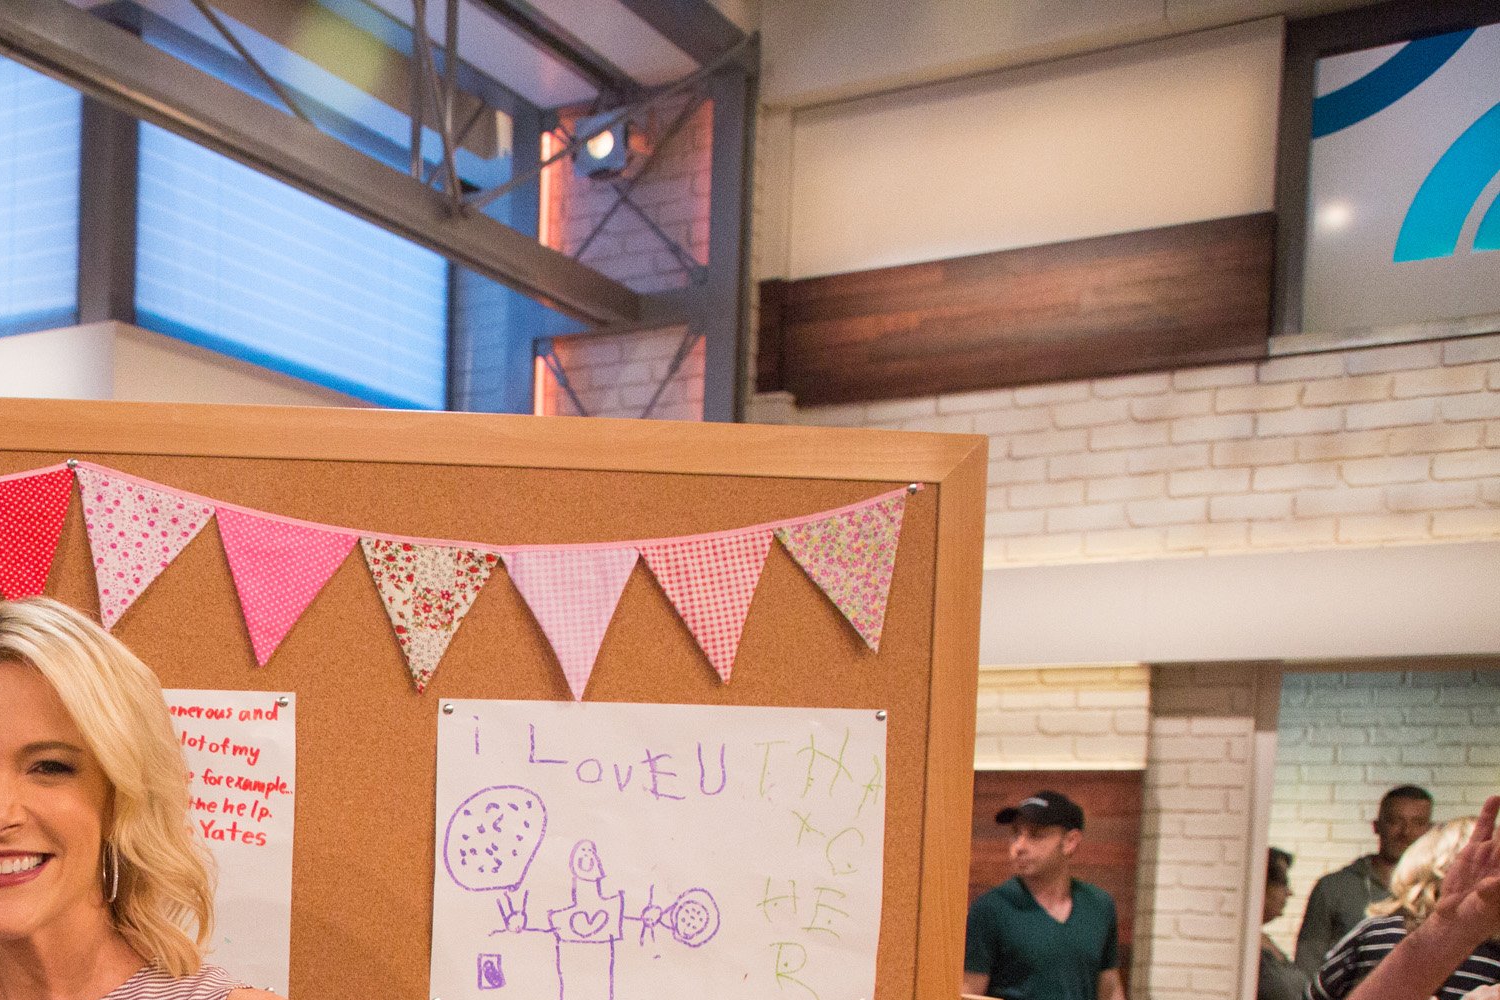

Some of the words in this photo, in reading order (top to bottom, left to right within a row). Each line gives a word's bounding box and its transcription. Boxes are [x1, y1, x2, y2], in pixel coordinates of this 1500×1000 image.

[169, 705, 233, 720] enerous
[238, 701, 280, 722] and
[209, 737, 231, 755] of
[231, 744, 261, 767] my
[201, 768, 224, 787] for
[199, 818, 268, 847] Yates
